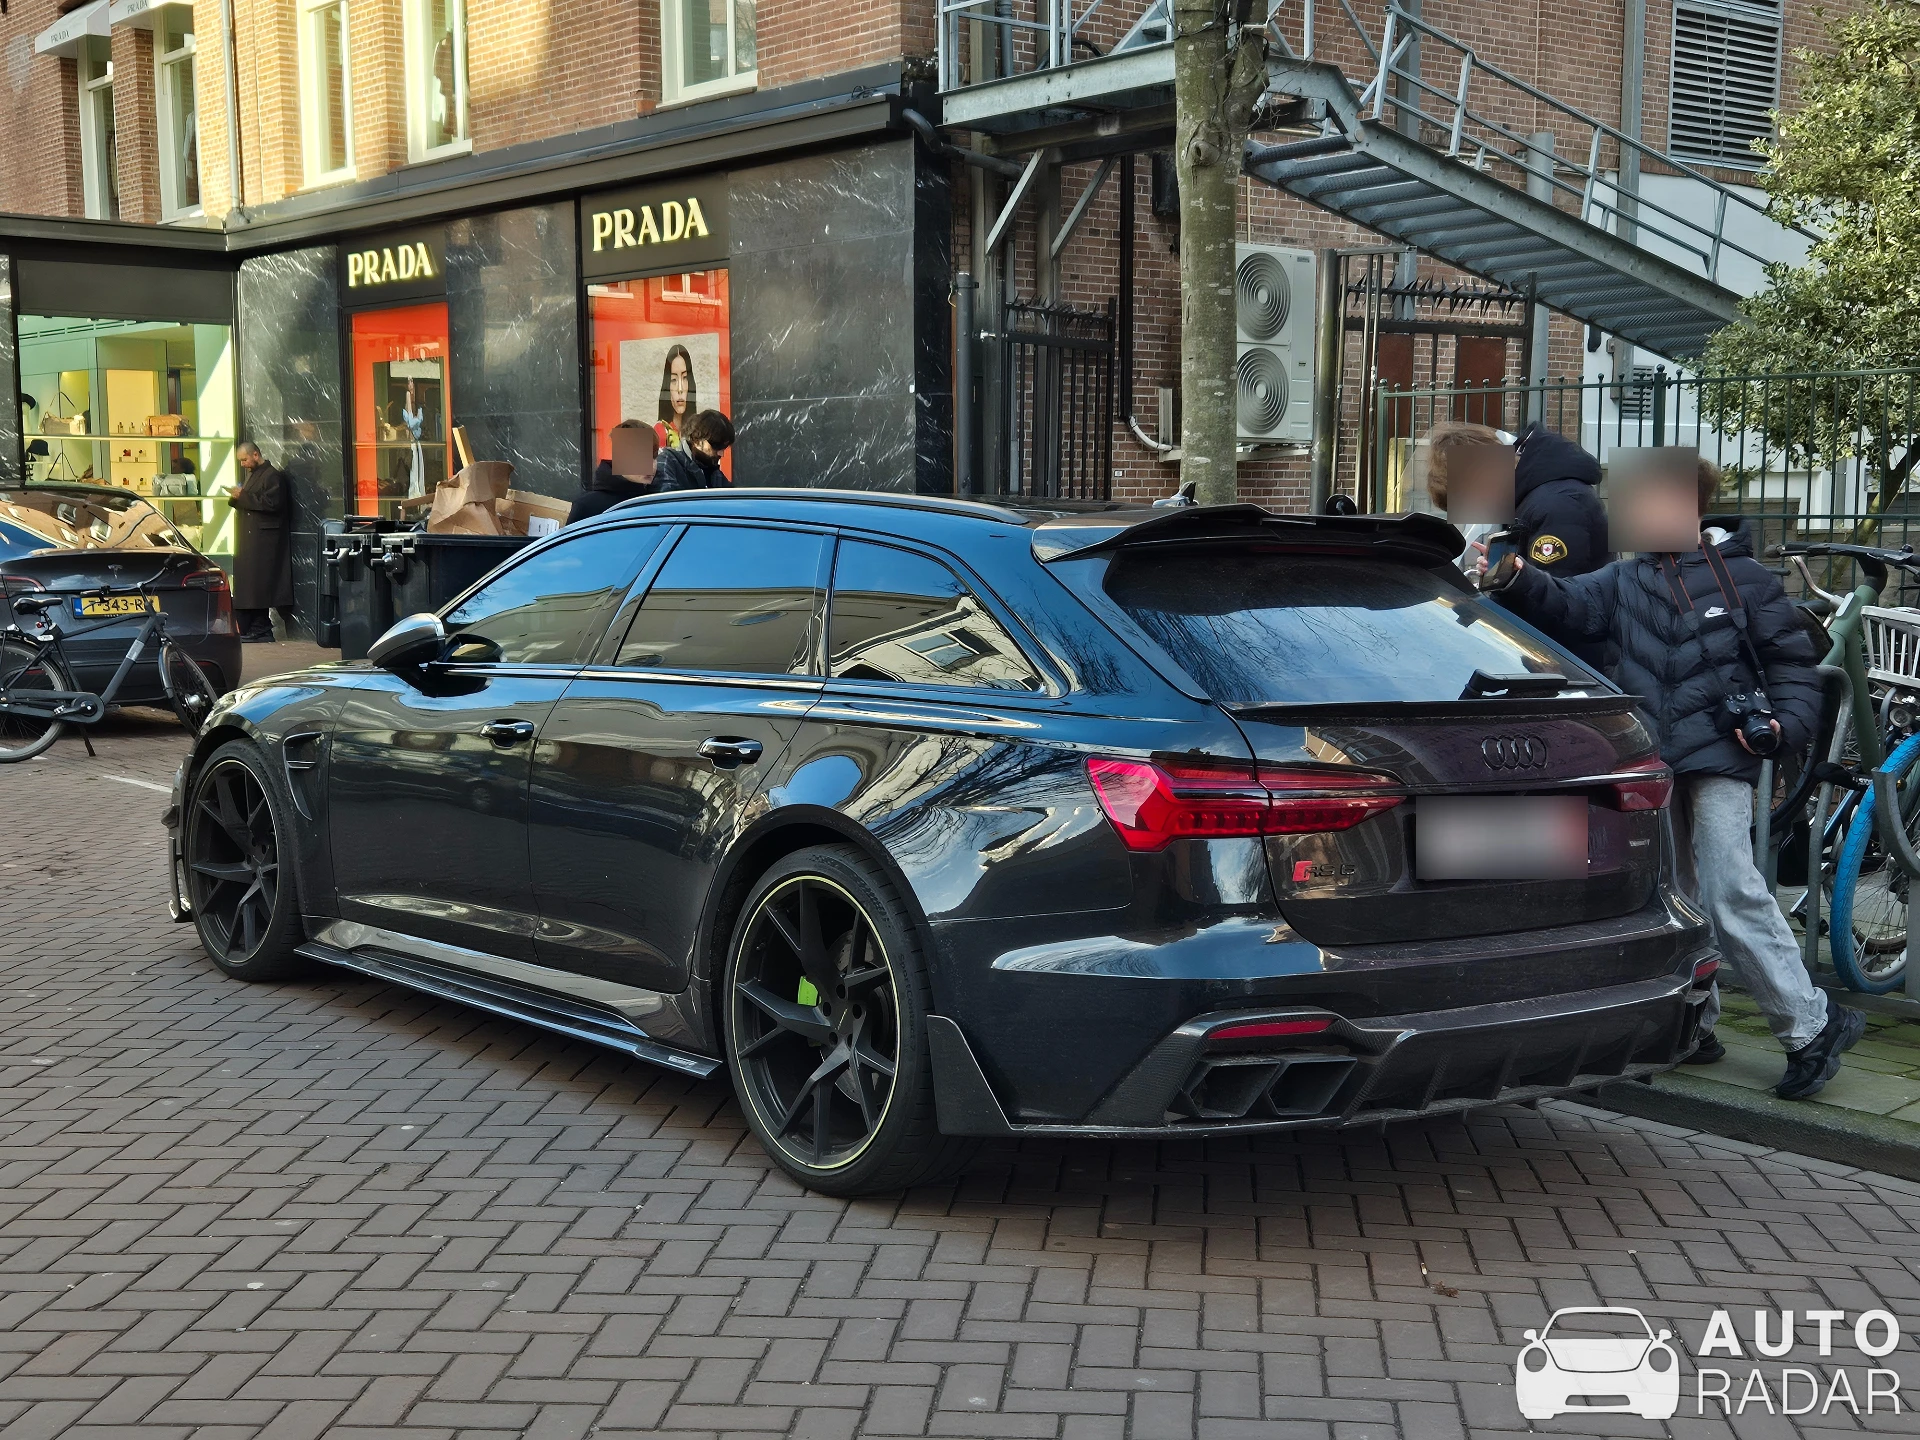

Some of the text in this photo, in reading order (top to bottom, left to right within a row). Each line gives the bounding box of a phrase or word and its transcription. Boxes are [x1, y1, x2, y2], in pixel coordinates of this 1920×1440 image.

[127, 0, 148, 14] PRADA
[50, 29, 70, 44] PRADA
[591, 197, 709, 252] PRADA
[347, 242, 434, 287] PRADA
[88, 598, 155, 613] T-343-R
